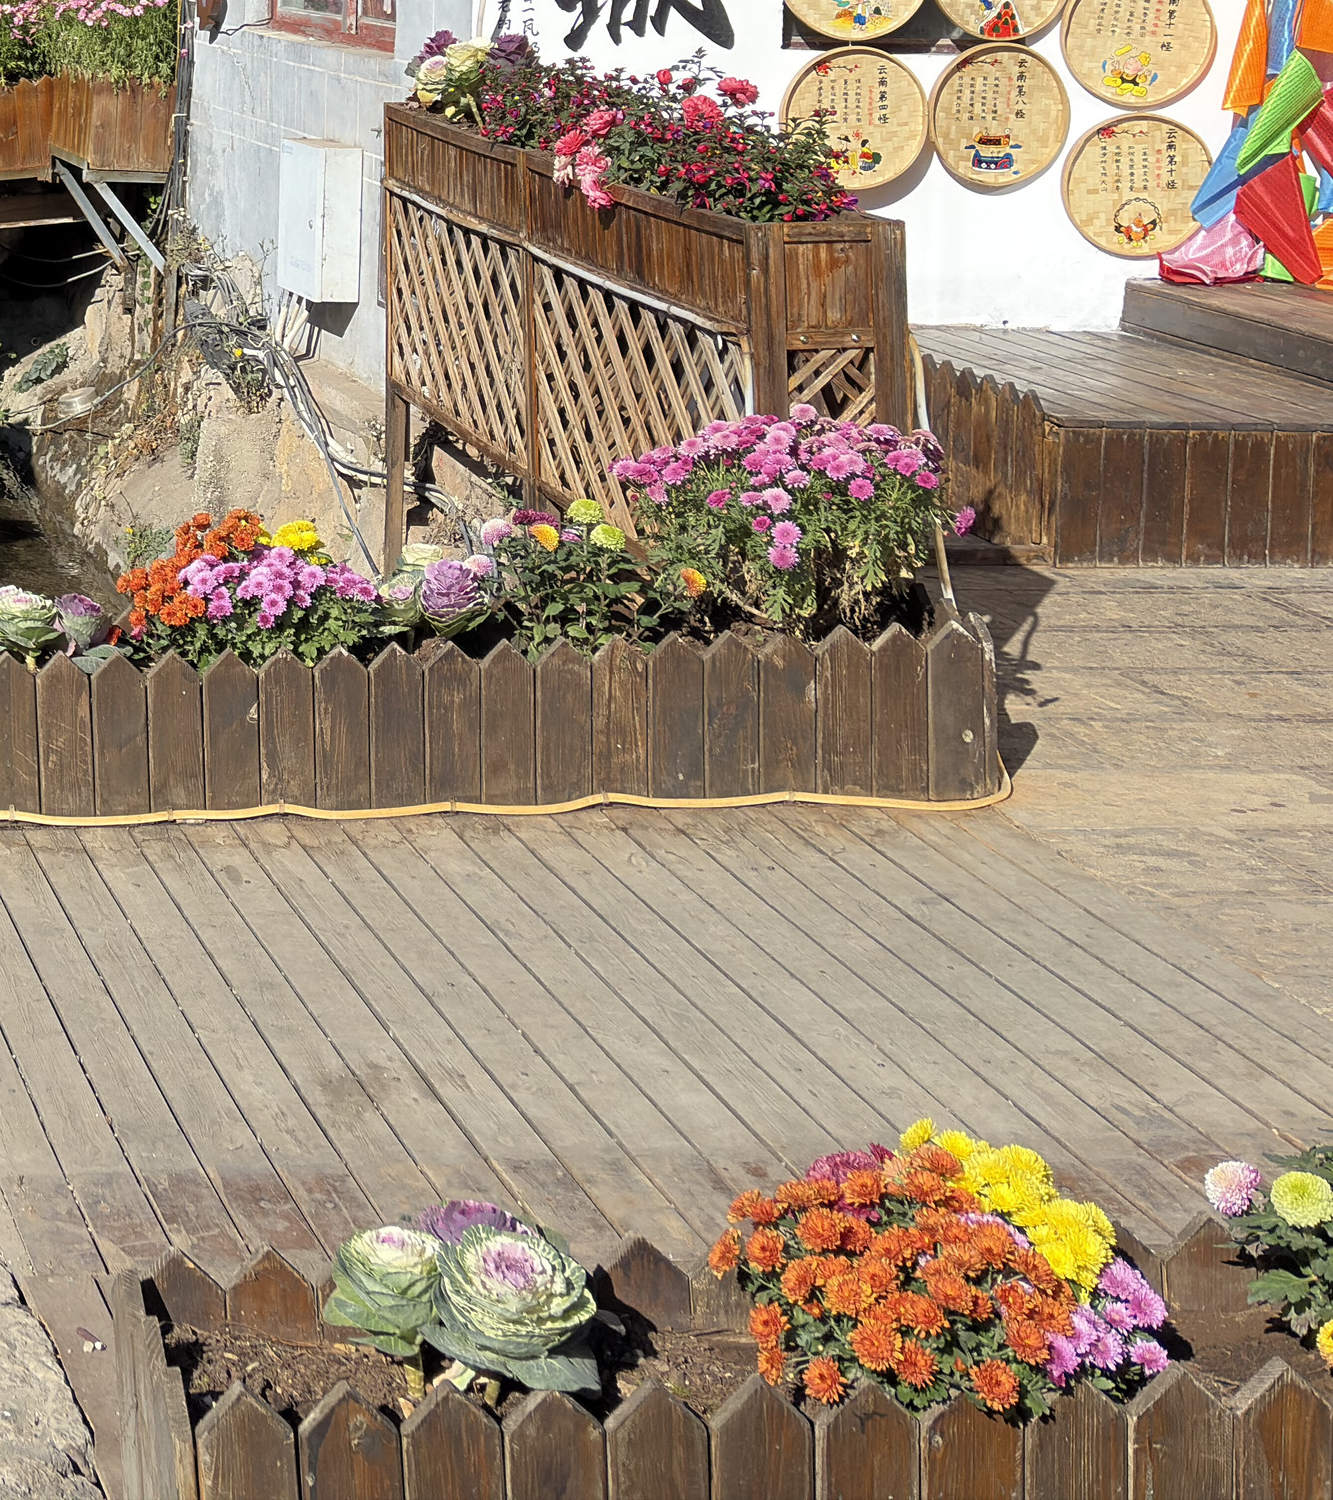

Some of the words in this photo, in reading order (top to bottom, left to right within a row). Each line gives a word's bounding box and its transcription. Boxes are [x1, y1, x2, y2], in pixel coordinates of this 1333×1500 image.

[877, 65, 889, 124] 云南第四怪
[1015, 59, 1028, 119] 云南第八怪
[1165, 129, 1178, 190] 云南第十怪
